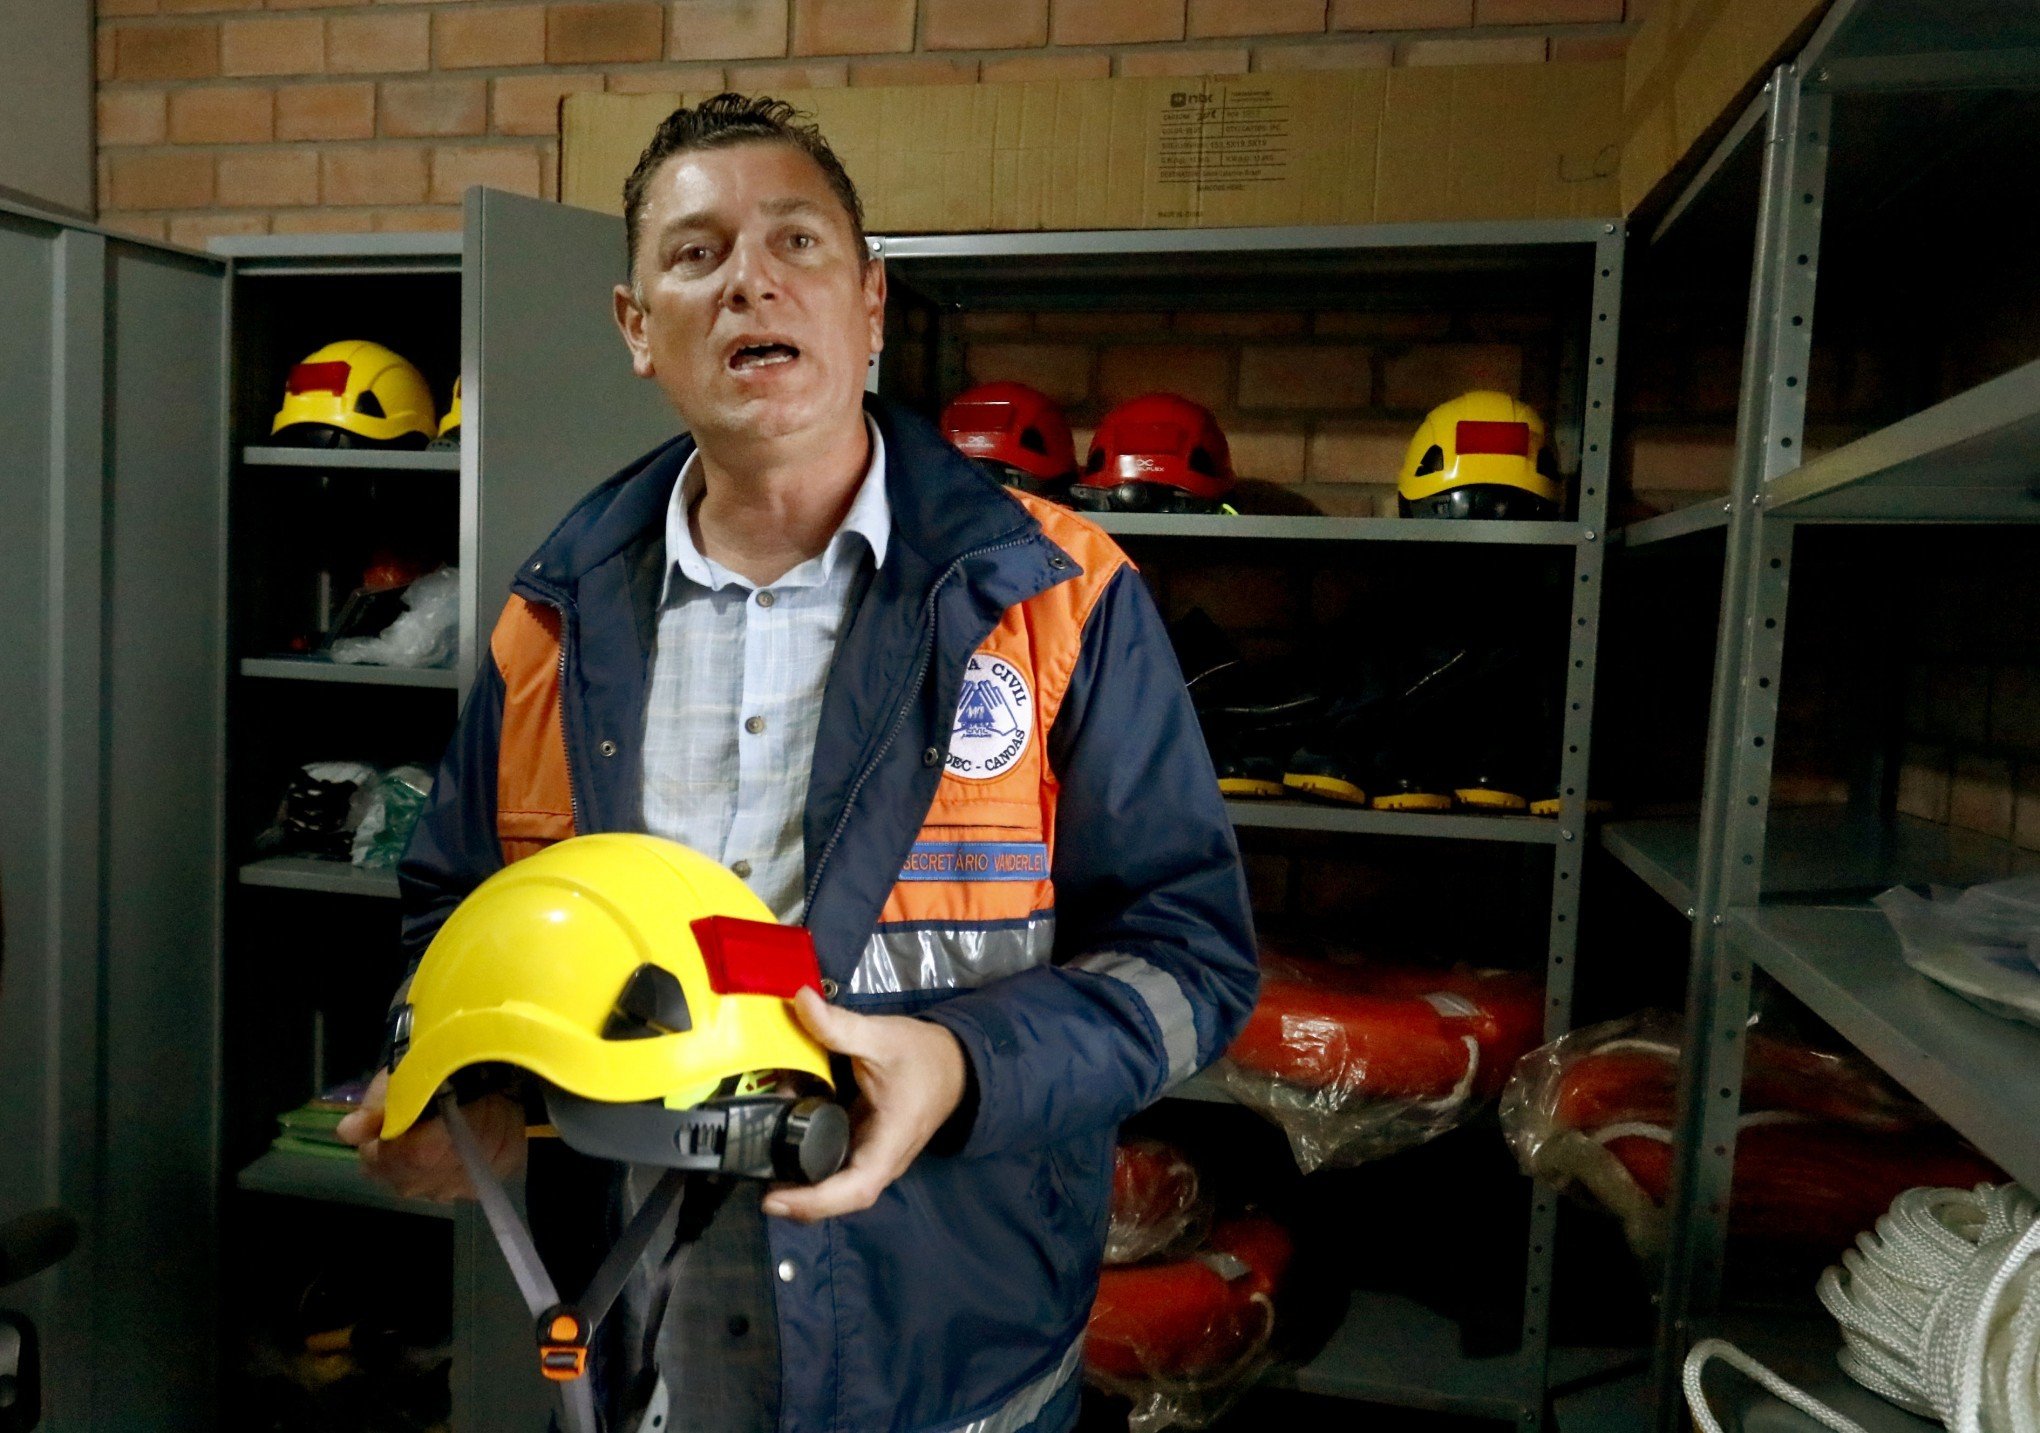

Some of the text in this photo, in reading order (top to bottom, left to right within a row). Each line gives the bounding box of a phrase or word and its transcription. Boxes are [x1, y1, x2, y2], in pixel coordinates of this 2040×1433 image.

[991, 663, 1027, 707] CIVIL
[985, 730, 1025, 770] CANOAS
[994, 853, 1045, 872] VANDERLEI
